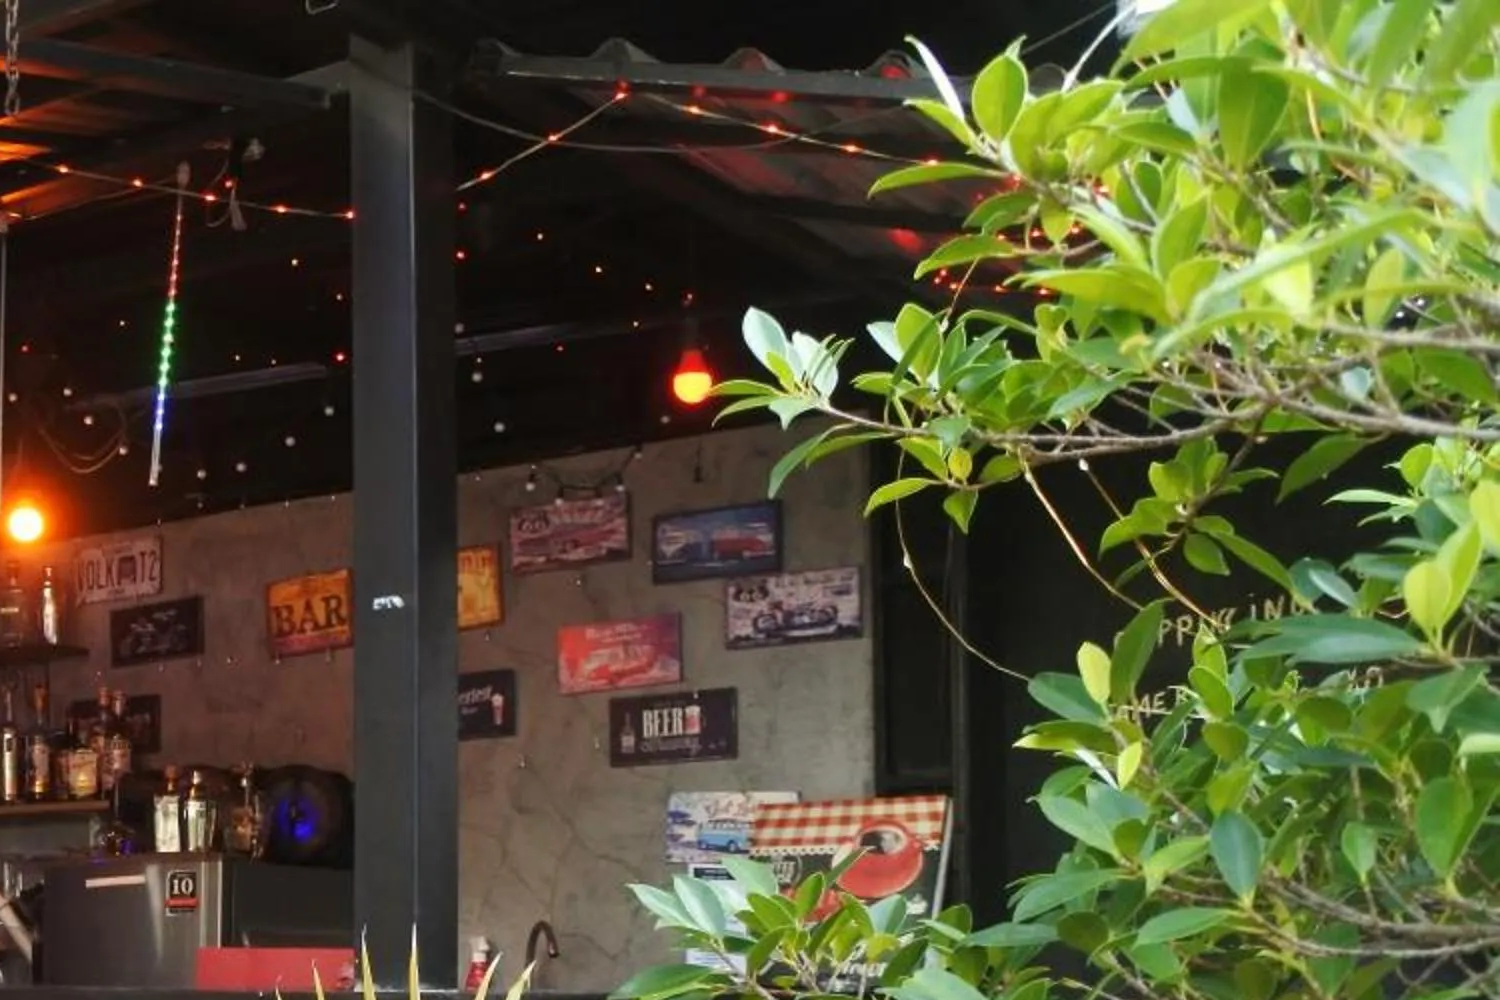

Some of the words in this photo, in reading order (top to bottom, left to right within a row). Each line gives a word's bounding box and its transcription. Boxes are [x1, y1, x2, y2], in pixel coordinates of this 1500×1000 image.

[274, 594, 347, 638] BAR
[642, 706, 684, 738] BEER
[172, 878, 194, 896] 10
